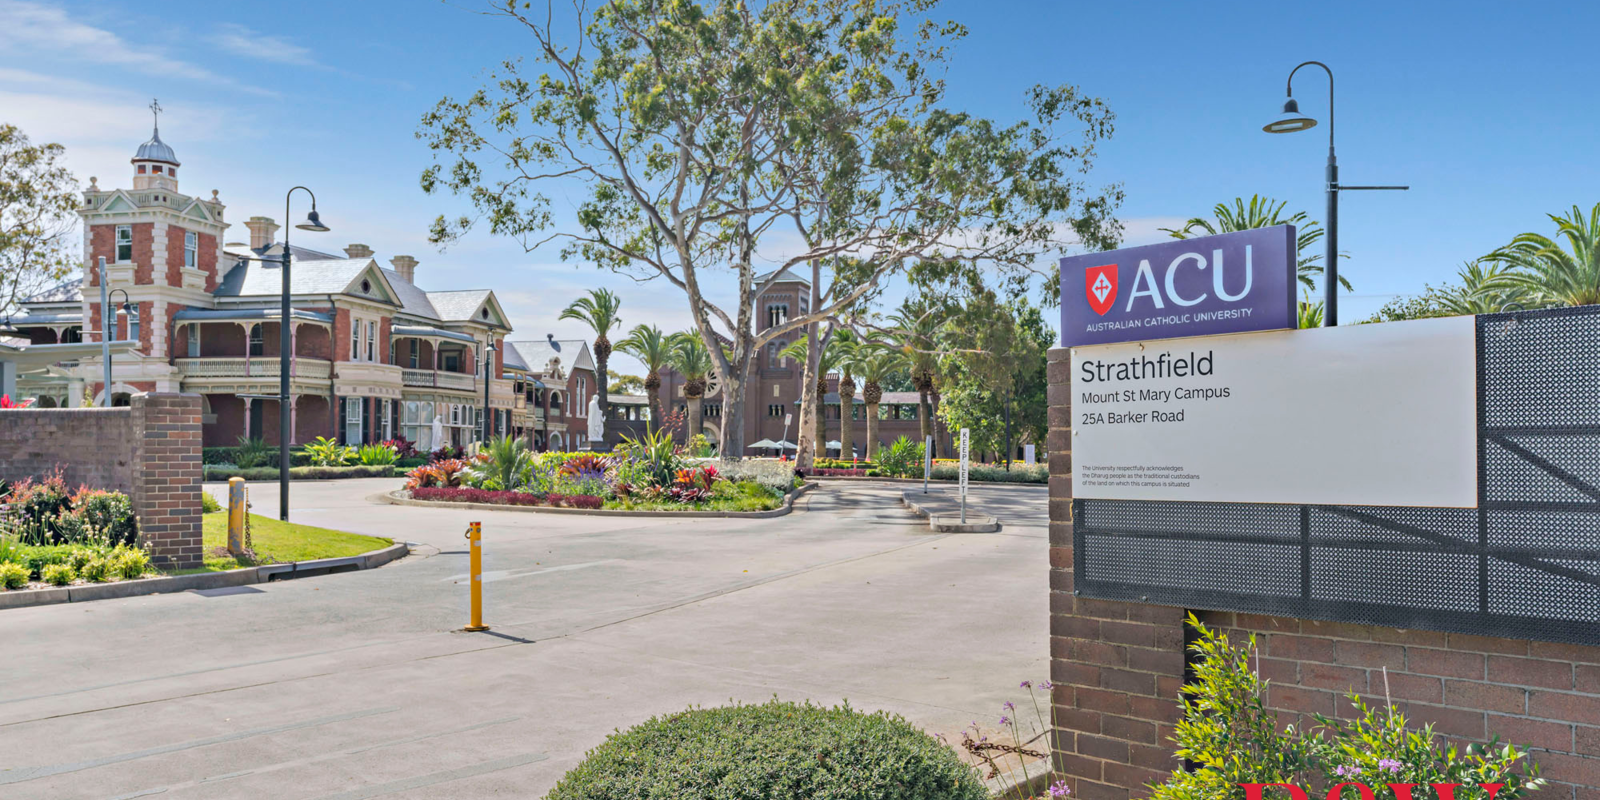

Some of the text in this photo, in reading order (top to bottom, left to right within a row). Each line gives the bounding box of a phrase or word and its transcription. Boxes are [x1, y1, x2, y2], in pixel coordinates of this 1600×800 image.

[1125, 244, 1253, 313] ACU
[1086, 308, 1253, 332] AUSTRALIAN CATHOLIC UNIVERSITY
[1081, 350, 1213, 383] Strathfield
[1082, 387, 1230, 404] Mount St Mary Campus
[1082, 409, 1184, 425] 25A Barker Road
